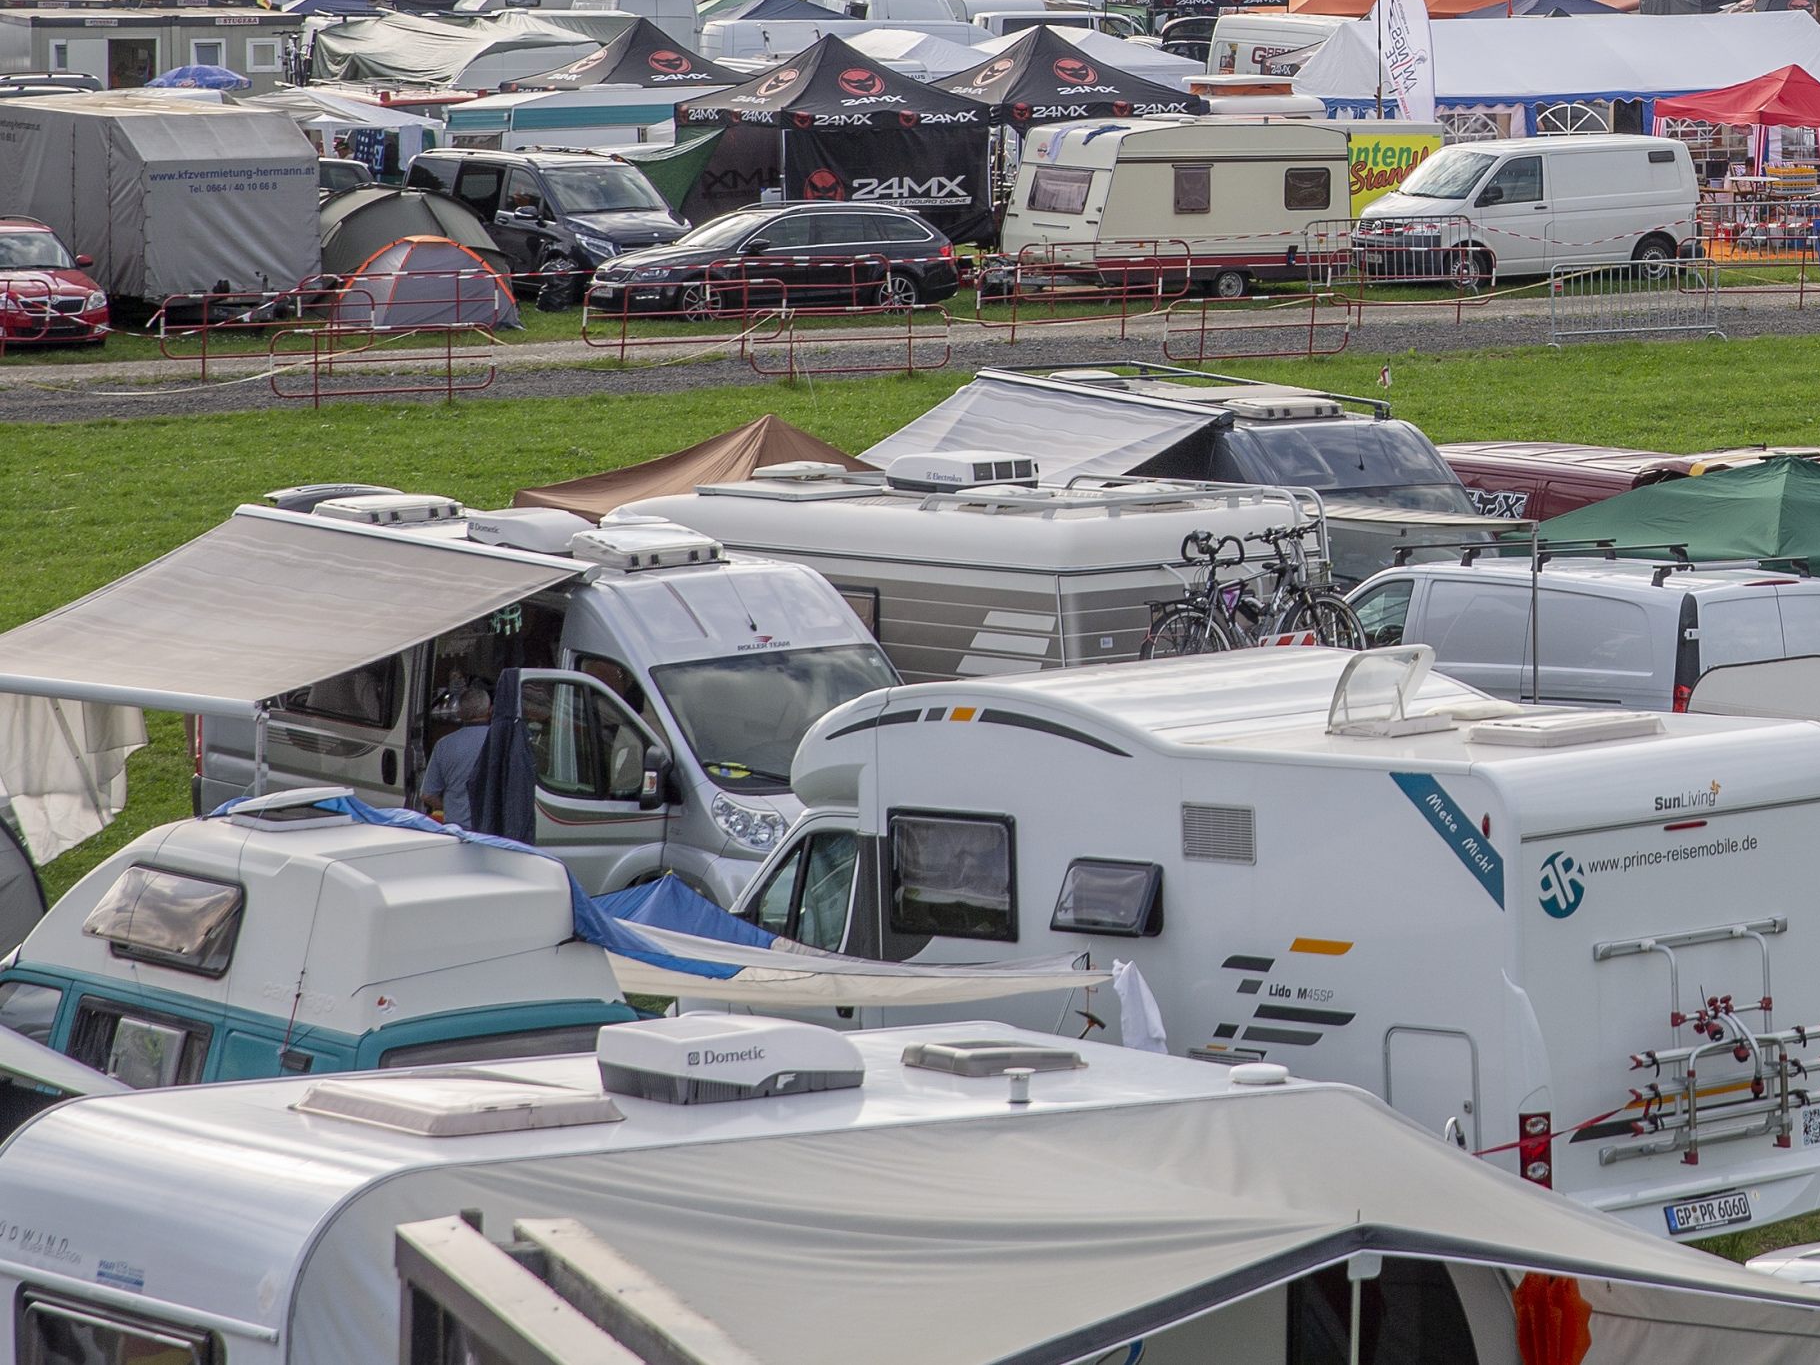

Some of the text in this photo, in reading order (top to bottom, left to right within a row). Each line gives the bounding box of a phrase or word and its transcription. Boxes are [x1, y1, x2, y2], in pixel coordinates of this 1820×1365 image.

[1057, 85, 1121, 95] 24MX
[842, 95, 907, 106] 24MX
[814, 115, 873, 126] 24MX
[920, 110, 979, 124] 24MX
[1032, 102, 1188, 118] 24MX 24MX
[150, 167, 315, 183] www.kfzvermietung-hermann.at
[852, 175, 969, 199] 24MX
[1655, 790, 1716, 811] SunLiving
[1427, 793, 1495, 873] Miete Mich!
[1588, 835, 1758, 876] www.prince-reisemobile.de
[1269, 984, 1291, 998] Lido
[704, 1047, 765, 1065] Dometic
[1676, 1208, 1692, 1227] GP
[1700, 1205, 1717, 1224] PR
[1718, 1197, 1748, 1220] 6060
